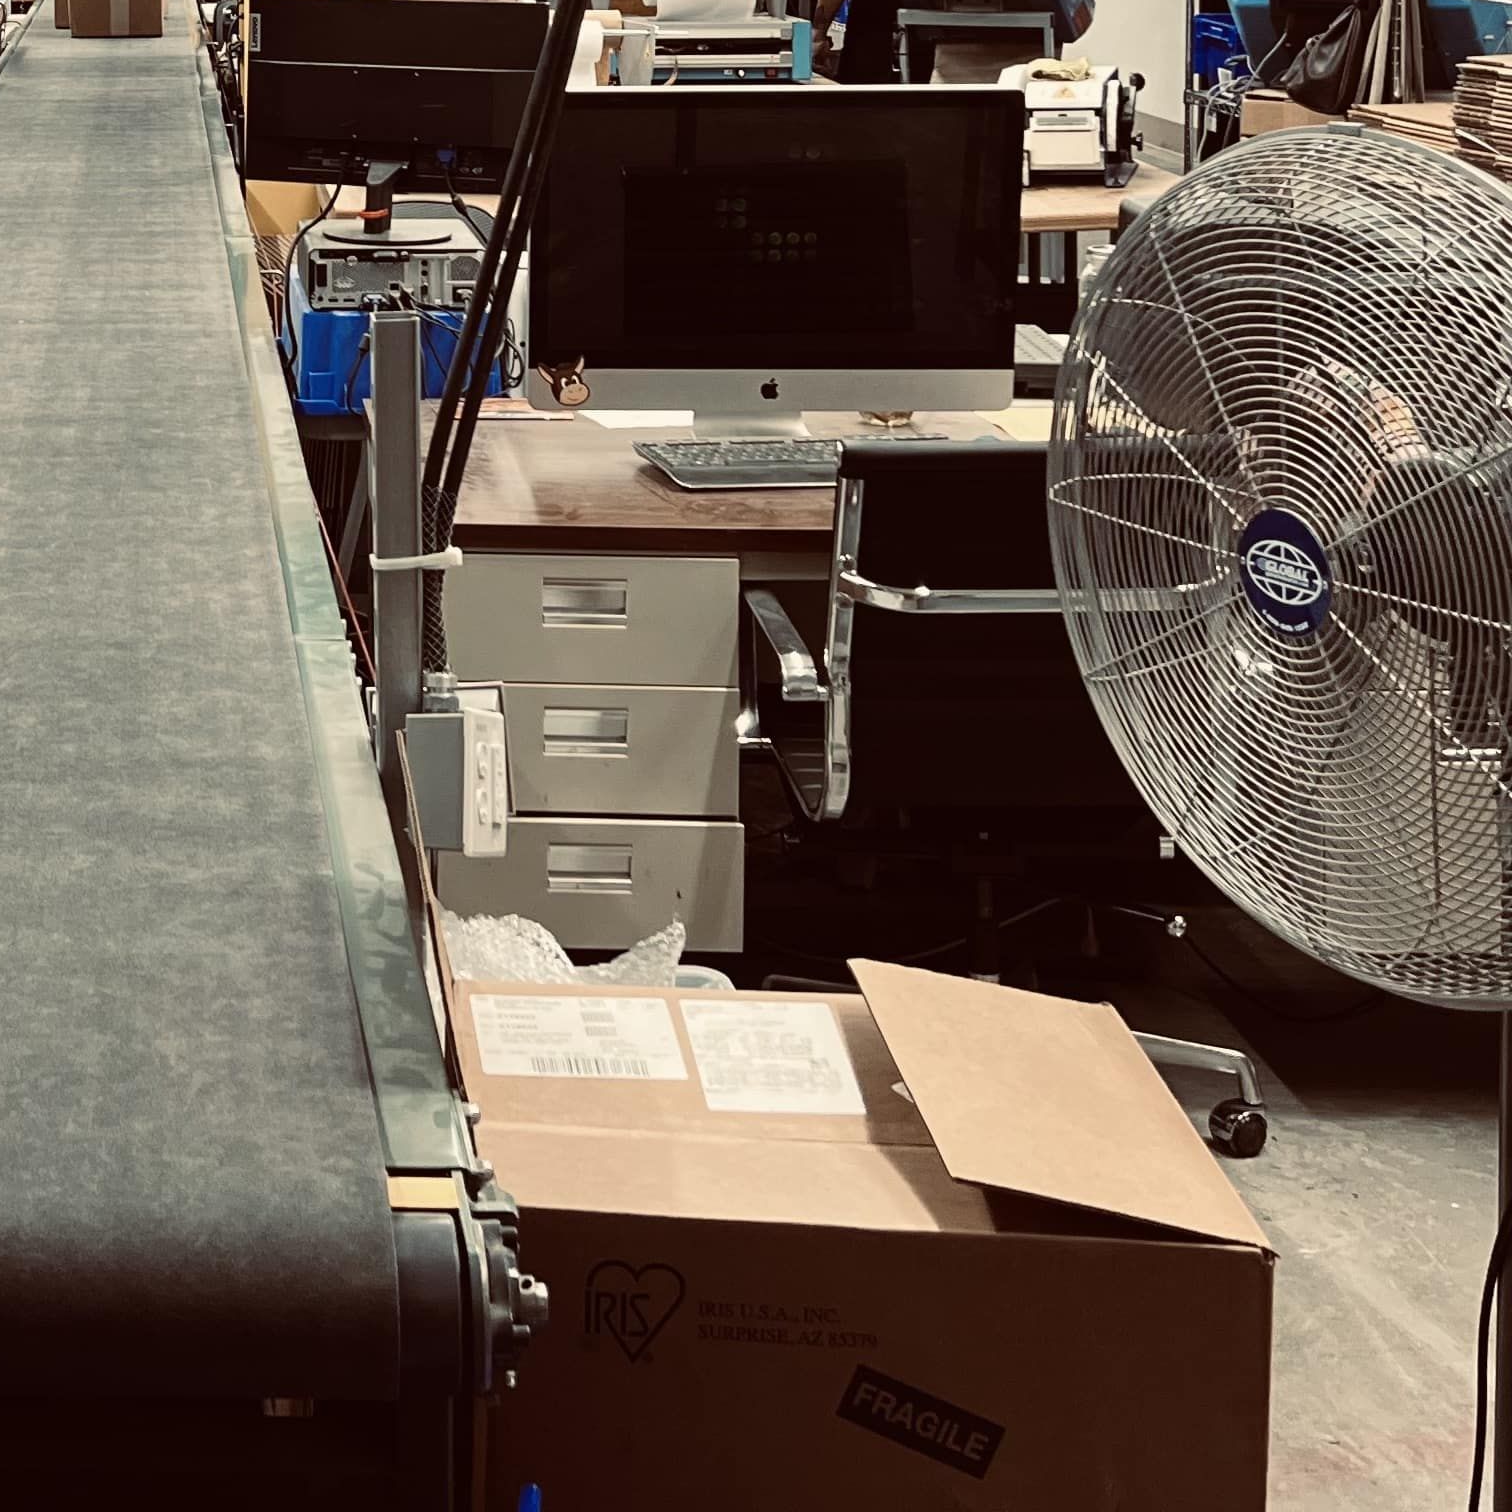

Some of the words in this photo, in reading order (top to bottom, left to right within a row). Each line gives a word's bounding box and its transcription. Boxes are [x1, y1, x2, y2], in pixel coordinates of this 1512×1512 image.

[584, 1287, 651, 1337] IRIS
[698, 1302, 736, 1319] IRIS
[798, 1329, 825, 1347] AZ
[853, 1382, 990, 1462] FRAGILE
